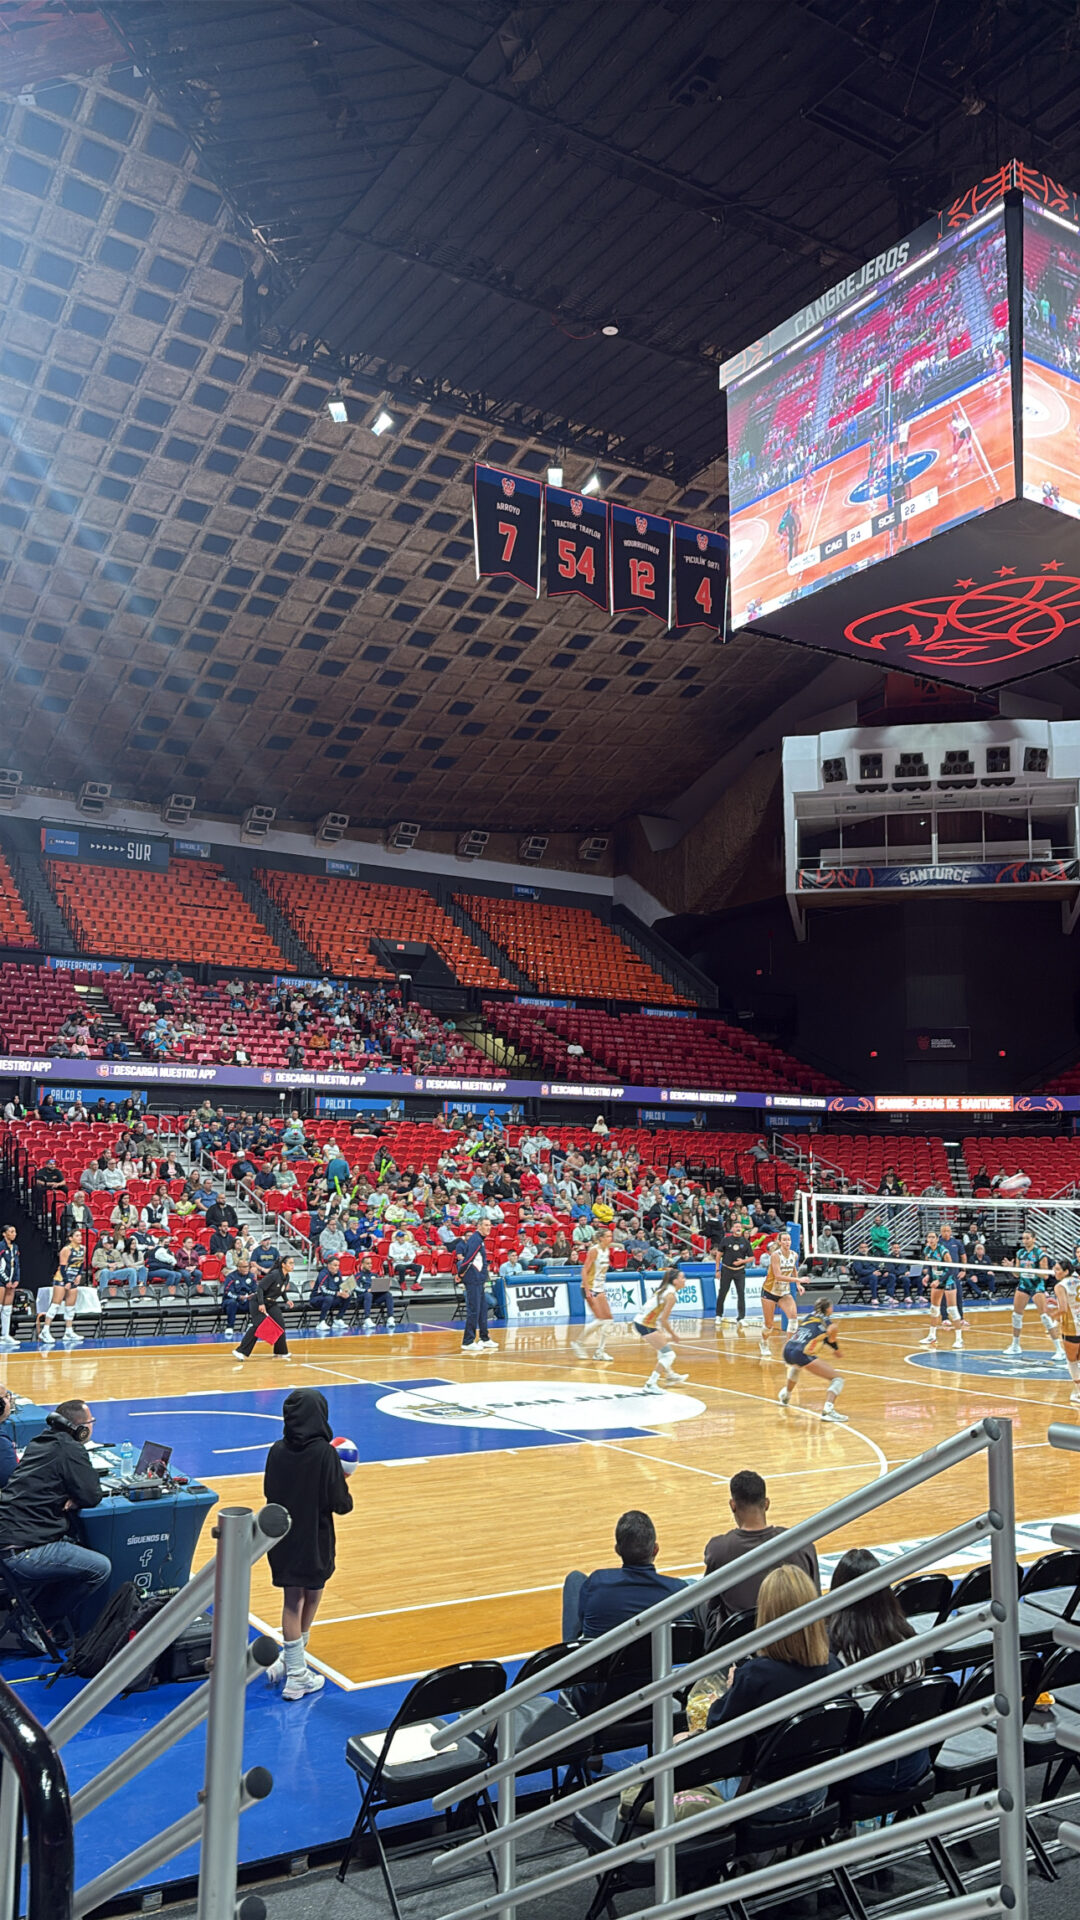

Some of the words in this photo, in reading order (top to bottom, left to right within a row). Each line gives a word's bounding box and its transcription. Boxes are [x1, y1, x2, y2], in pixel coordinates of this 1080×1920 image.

[793, 242, 910, 337] CANGREJEROS
[496, 502, 521, 516] ARROYO
[825, 539, 843, 555] CAG
[850, 531, 861, 543] 24
[904, 503, 916, 516] 22
[498, 521, 518, 562] 7
[558, 538, 596, 585] 54
[629, 558, 656, 600] 12
[694, 577, 712, 614] 4
[127, 842, 152, 861] SUR
[900, 867, 972, 885] SANTURCE
[32, 1061, 52, 1073] APP
[113, 1065, 158, 1078] DESCARGA
[159, 1067, 198, 1079] NUESTRO
[198, 1068, 217, 1080] APP
[275, 1072, 315, 1084] DESCARGA
[316, 1074, 350, 1085] NUESTRO
[350, 1076, 367, 1086] APP
[492, 1082, 507, 1092] APP
[51, 1088, 75, 1101] PALCO
[325, 1098, 345, 1109] PALCO
[516, 1286, 559, 1299] LUCKY
[486, 1397, 565, 1409] SAN
[126, 1534, 160, 1546] SÍGUENOS
[160, 1533, 170, 1541] EN
